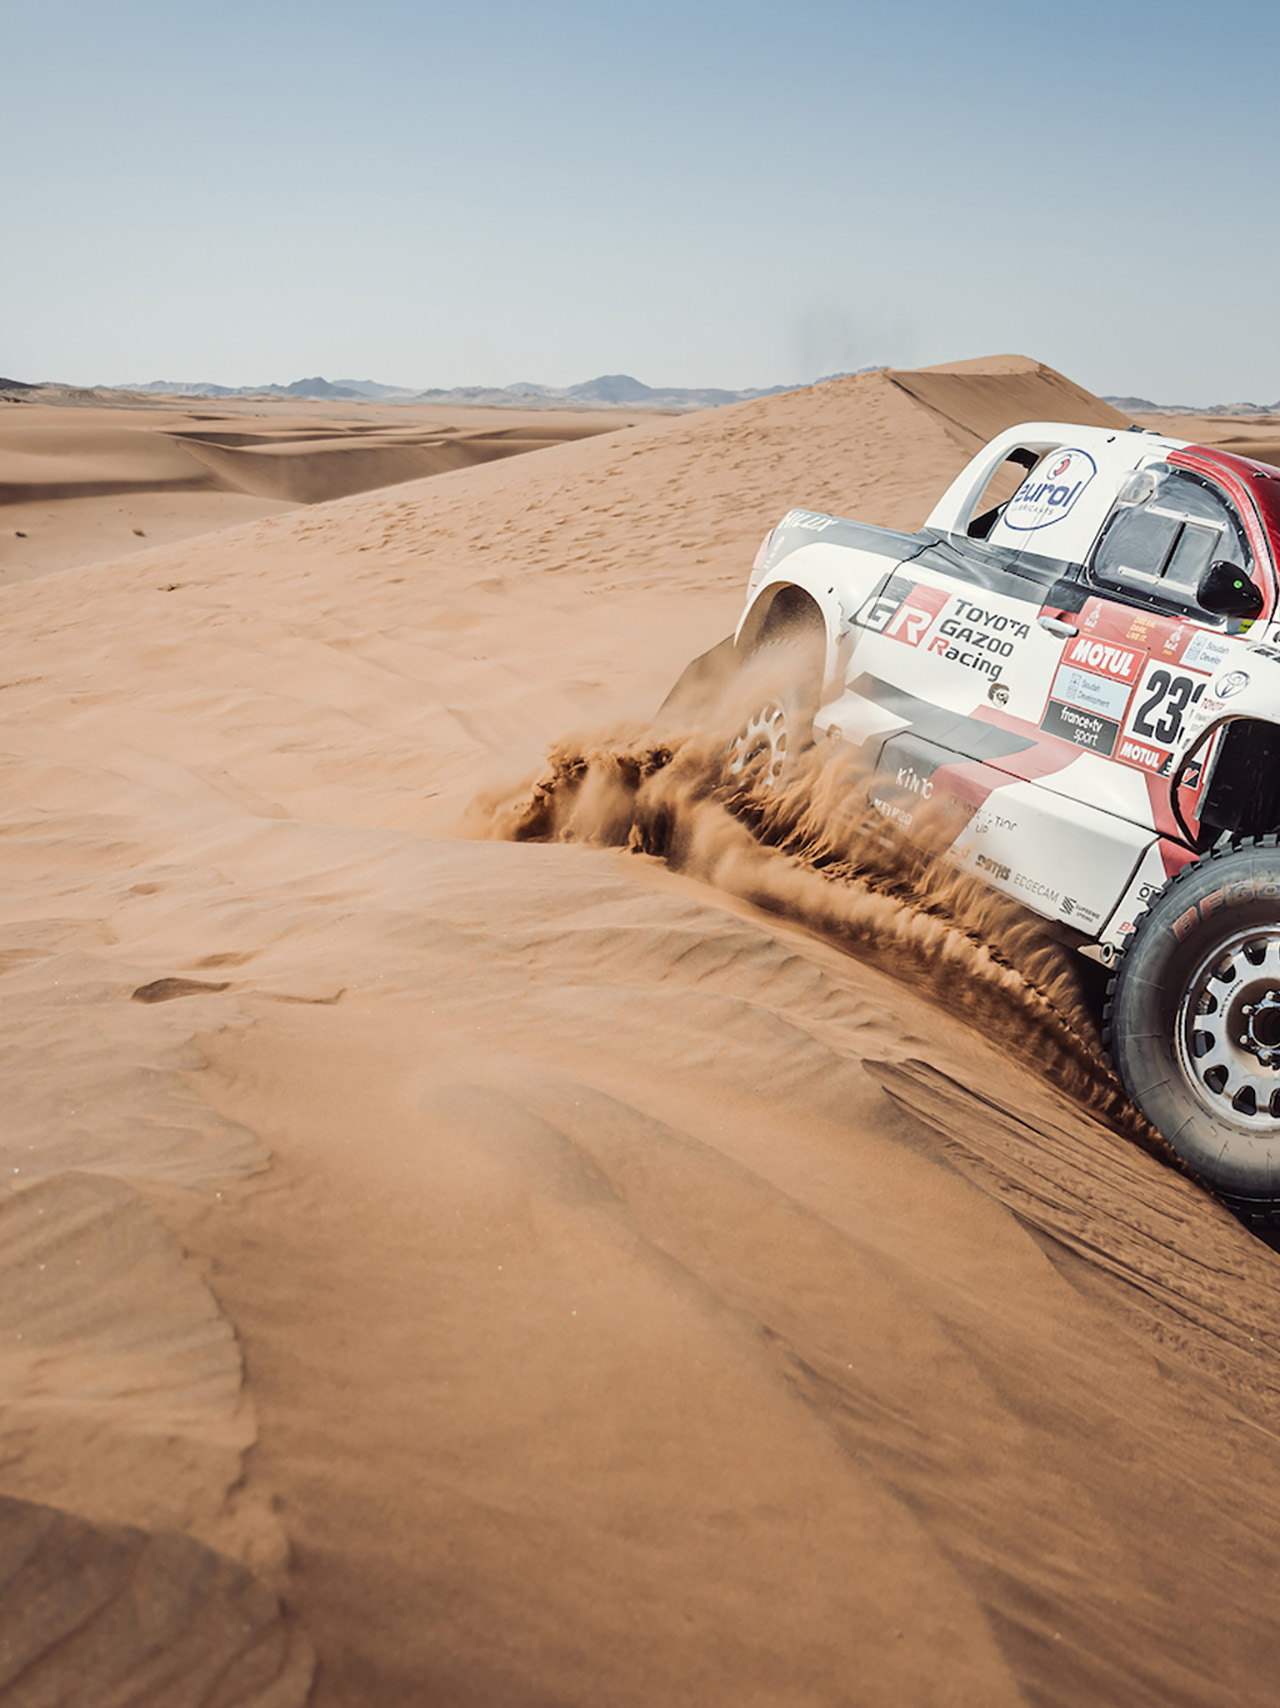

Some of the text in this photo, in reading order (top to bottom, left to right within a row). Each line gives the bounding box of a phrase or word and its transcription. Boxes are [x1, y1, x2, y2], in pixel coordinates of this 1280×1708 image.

[1014, 480, 1083, 508] eurol
[855, 596, 934, 645] GR
[938, 618, 1015, 658] GAZOO
[952, 598, 1032, 640] TOYOTA
[926, 635, 1004, 683] Racing
[1069, 638, 1135, 678] MOTUL
[1073, 728, 1099, 747] sport
[1119, 741, 1161, 769] MOTUL
